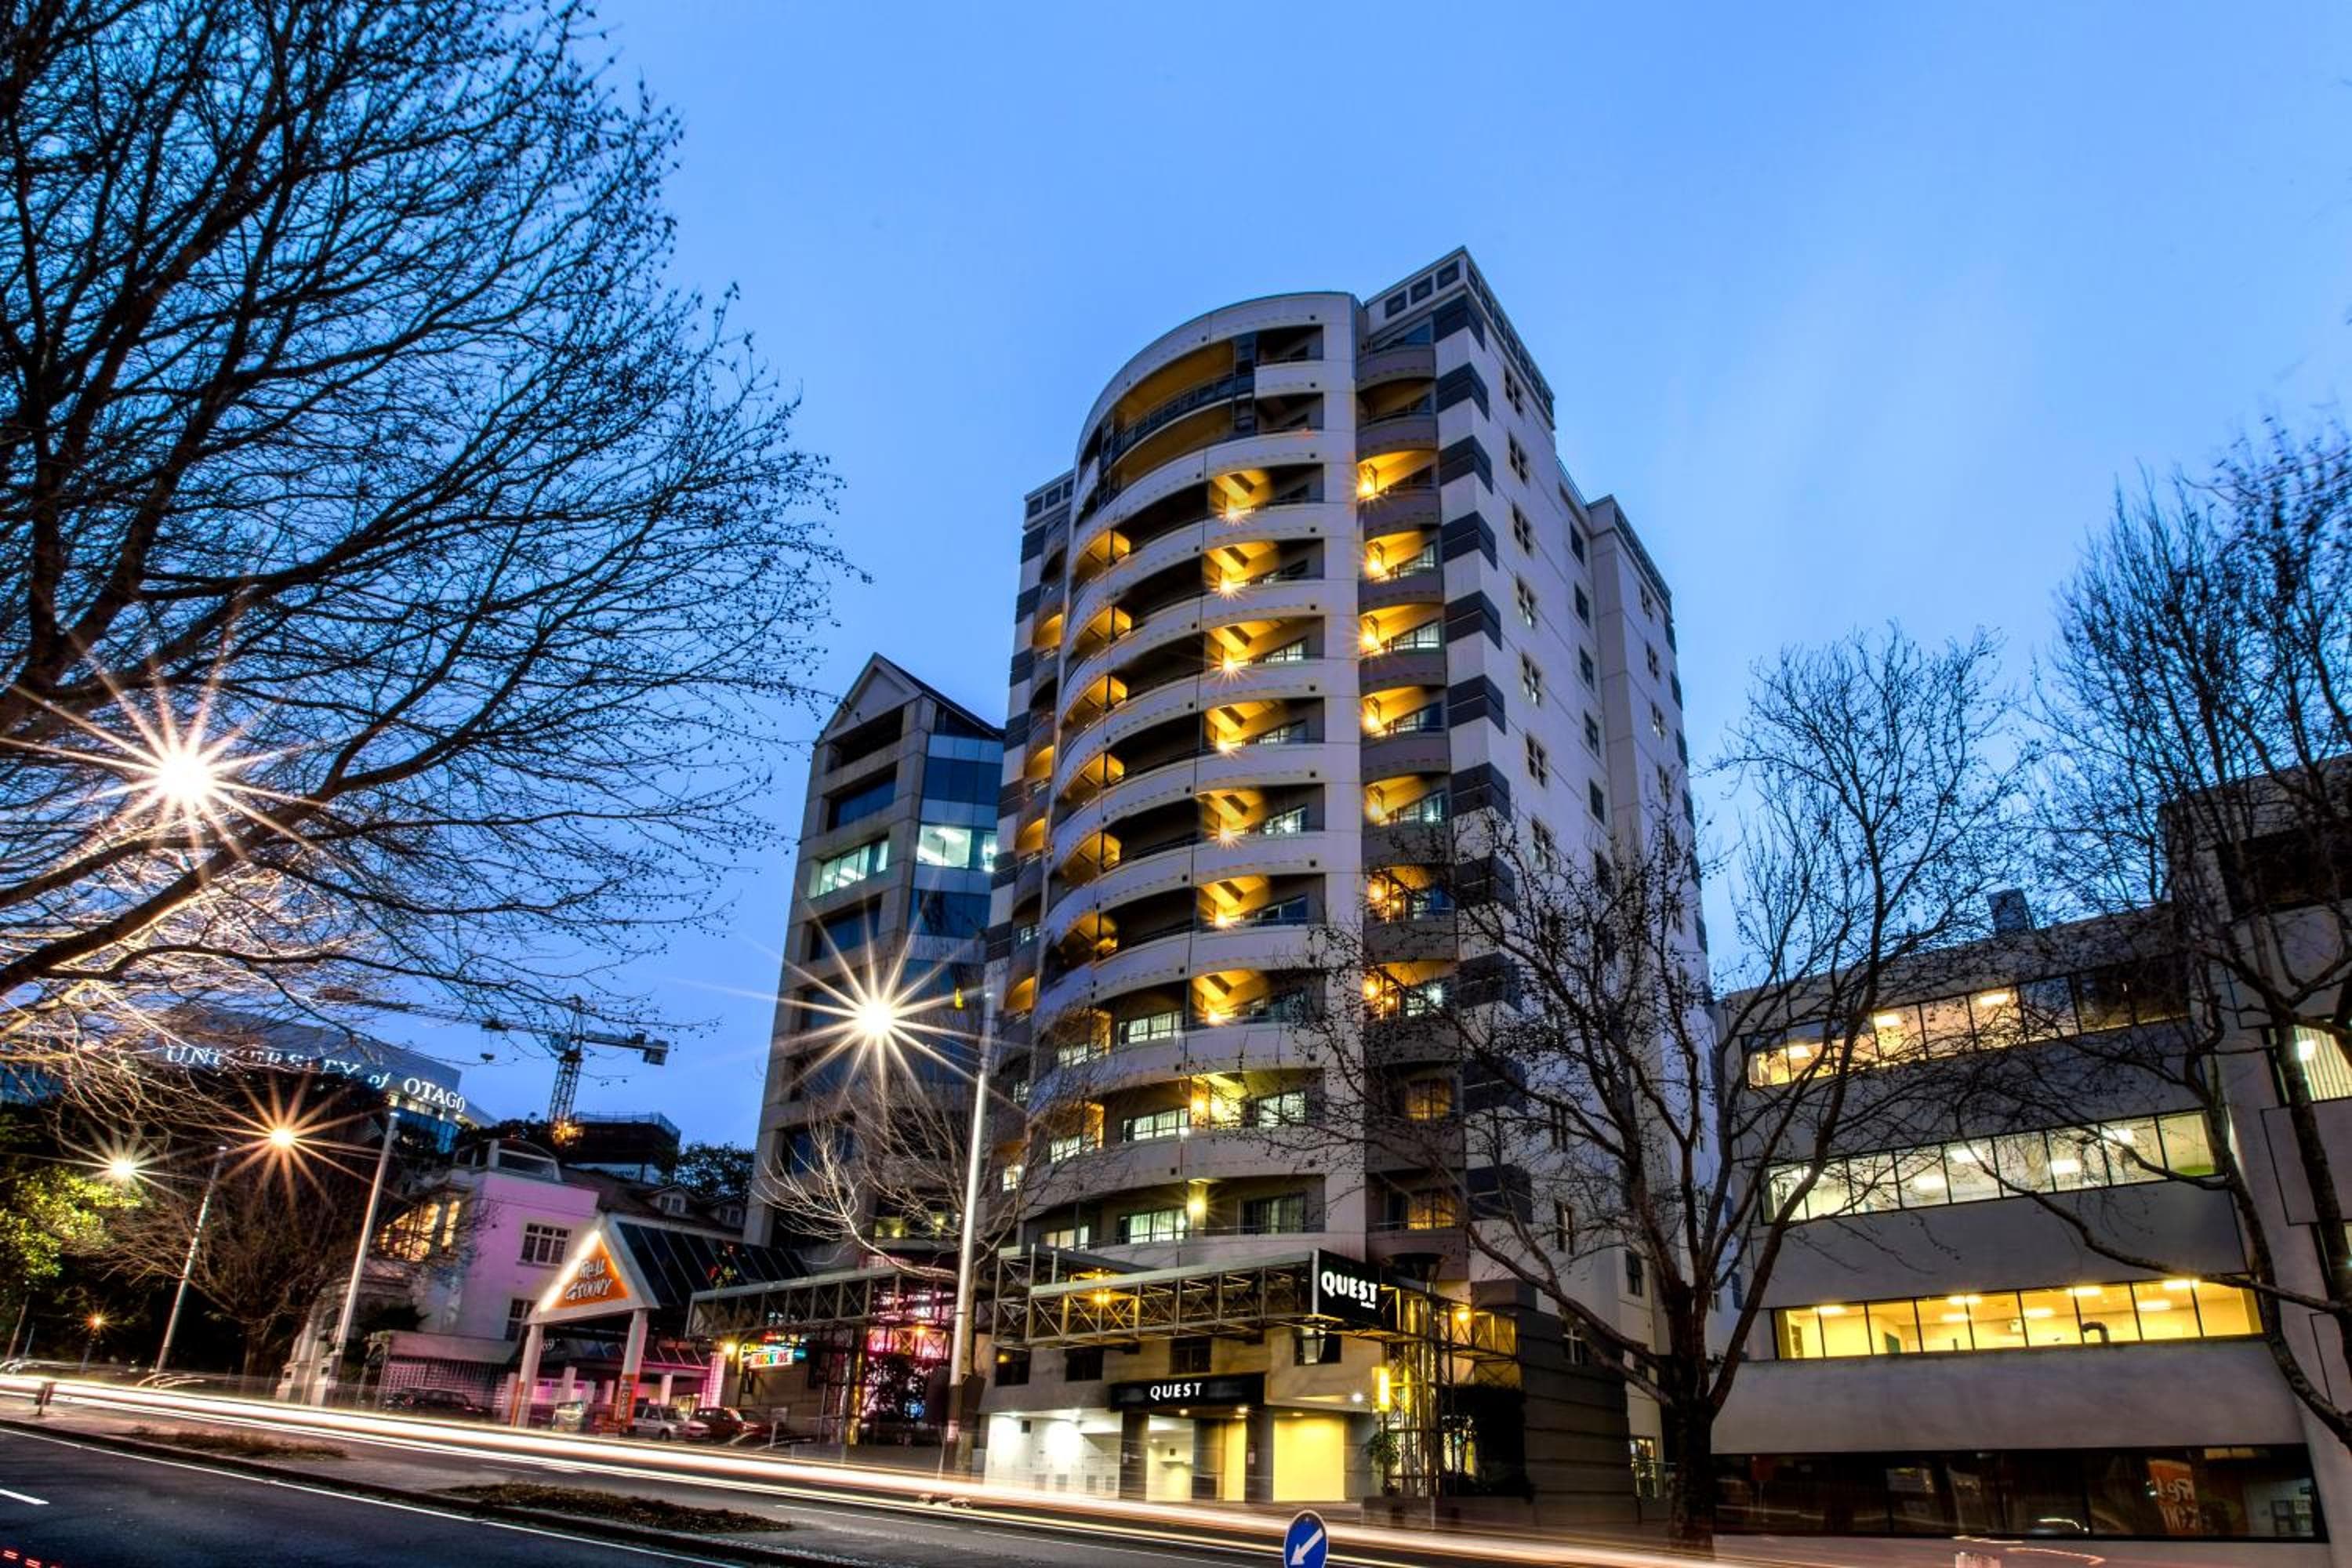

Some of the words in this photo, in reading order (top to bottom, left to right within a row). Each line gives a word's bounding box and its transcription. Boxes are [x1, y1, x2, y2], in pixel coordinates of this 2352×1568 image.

[368, 1073, 391, 1089] of
[403, 1077, 466, 1112] OTAGO
[1321, 1271, 1377, 1302] QUEST
[1149, 1382, 1202, 1401] QUEST
